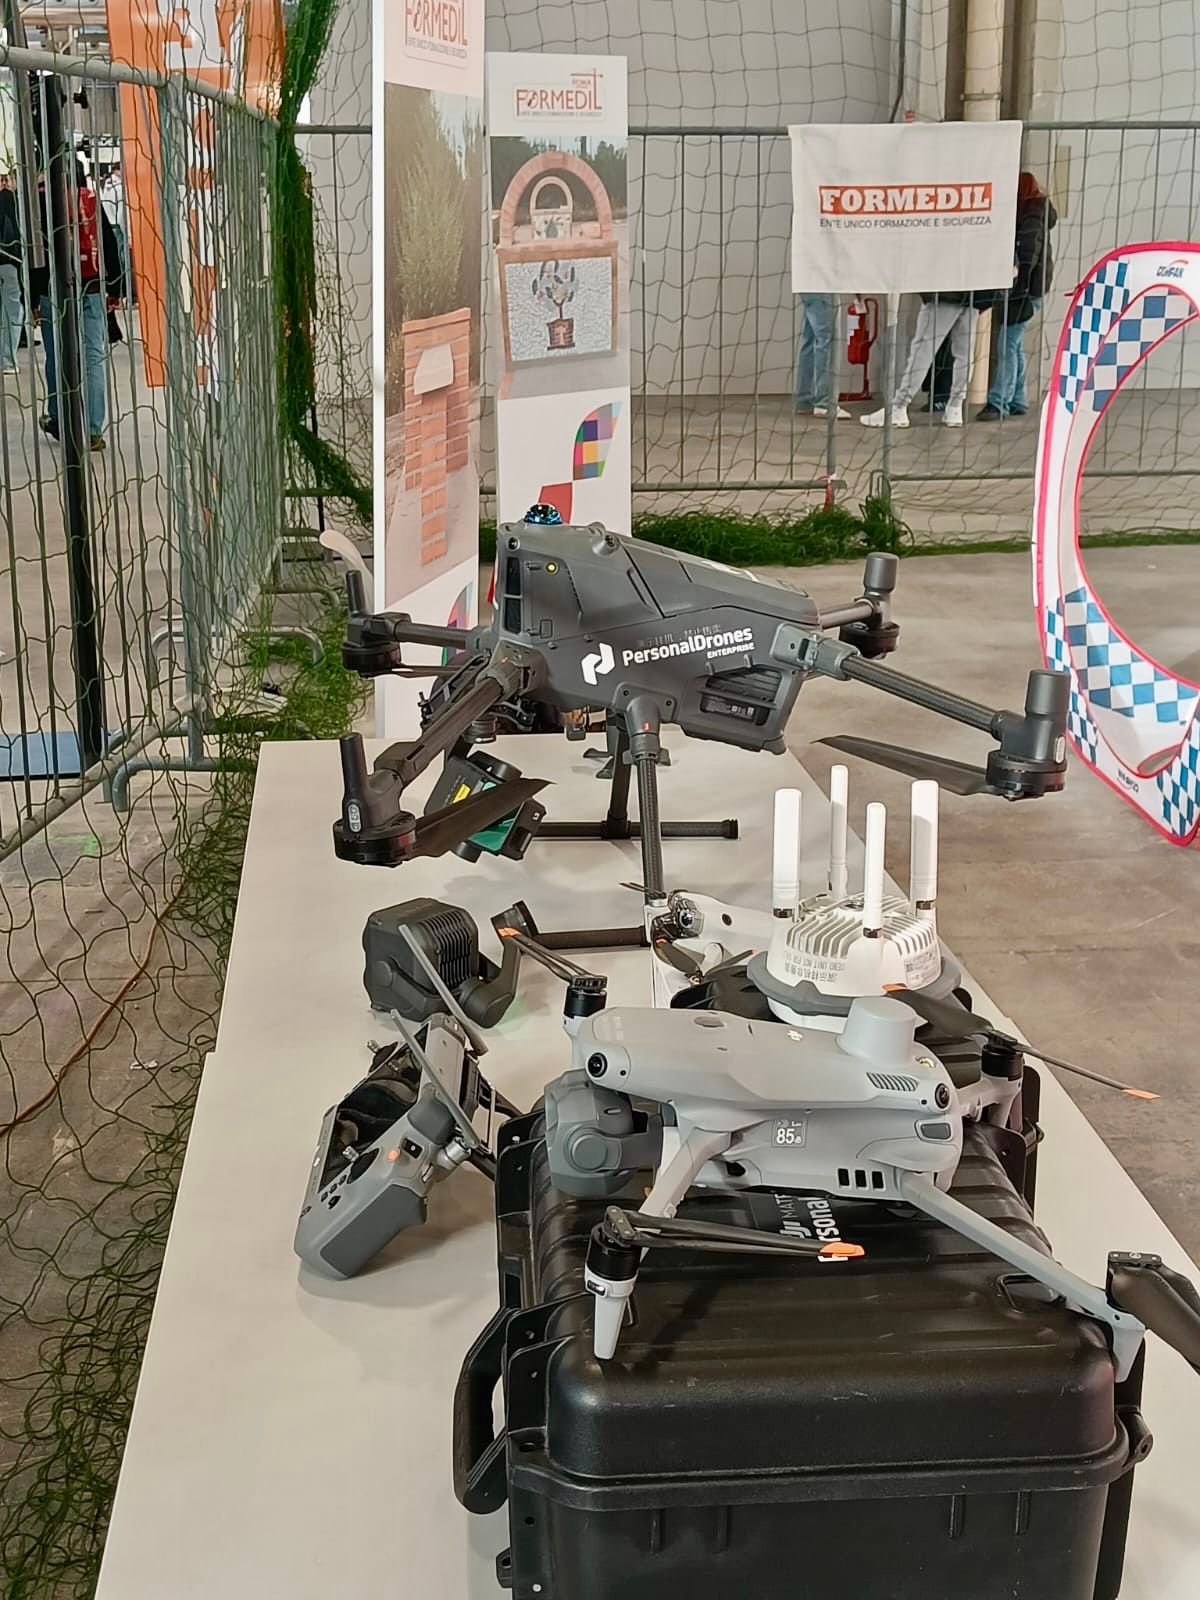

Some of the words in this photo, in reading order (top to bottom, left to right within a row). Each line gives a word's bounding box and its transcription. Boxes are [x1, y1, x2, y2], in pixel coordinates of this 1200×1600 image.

[516, 67, 603, 116] FORMEDIL
[820, 186, 991, 213] FORMEDIL
[843, 218, 873, 229] UNICO
[873, 217, 932, 229] FORMAZIONE
[933, 217, 940, 228] E
[942, 216, 992, 228] SICUREZZA
[621, 626, 753, 667] PersonalDrones
[706, 642, 756, 659] ENTERPRISE
[797, 1197, 849, 1263] rsonal
